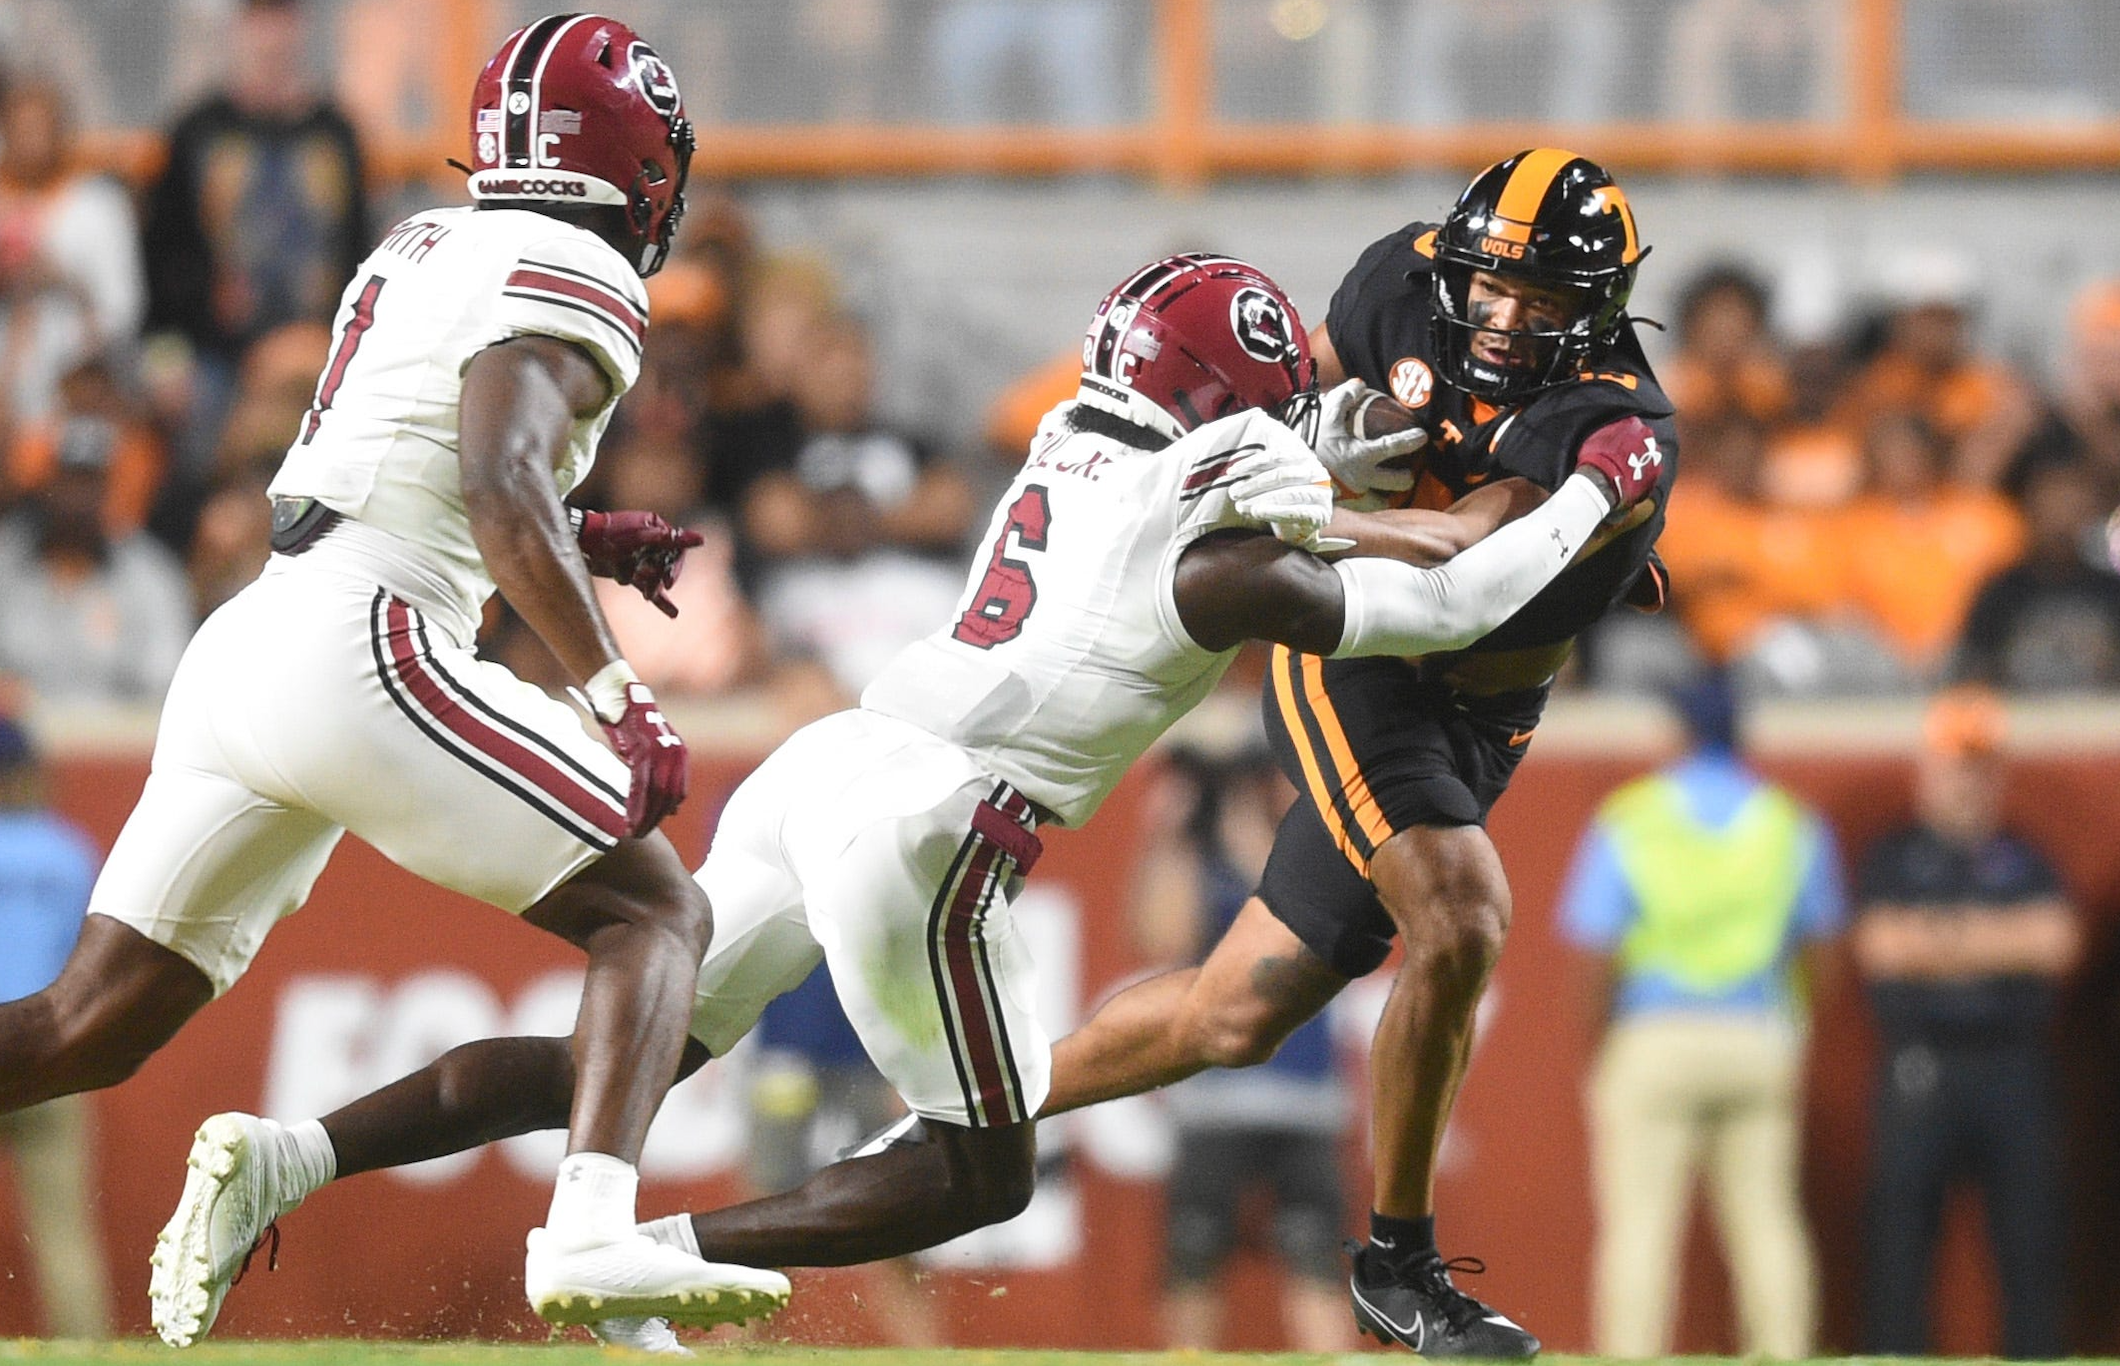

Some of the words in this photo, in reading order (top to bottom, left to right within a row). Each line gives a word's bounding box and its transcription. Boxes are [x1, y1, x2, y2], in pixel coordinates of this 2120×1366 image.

[538, 133, 561, 167] C
[1481, 238, 1523, 260] VOLS
[302, 274, 387, 445] 1
[1116, 352, 1136, 386] C
[1391, 359, 1431, 405] SEC
[951, 483, 1051, 650] 6
